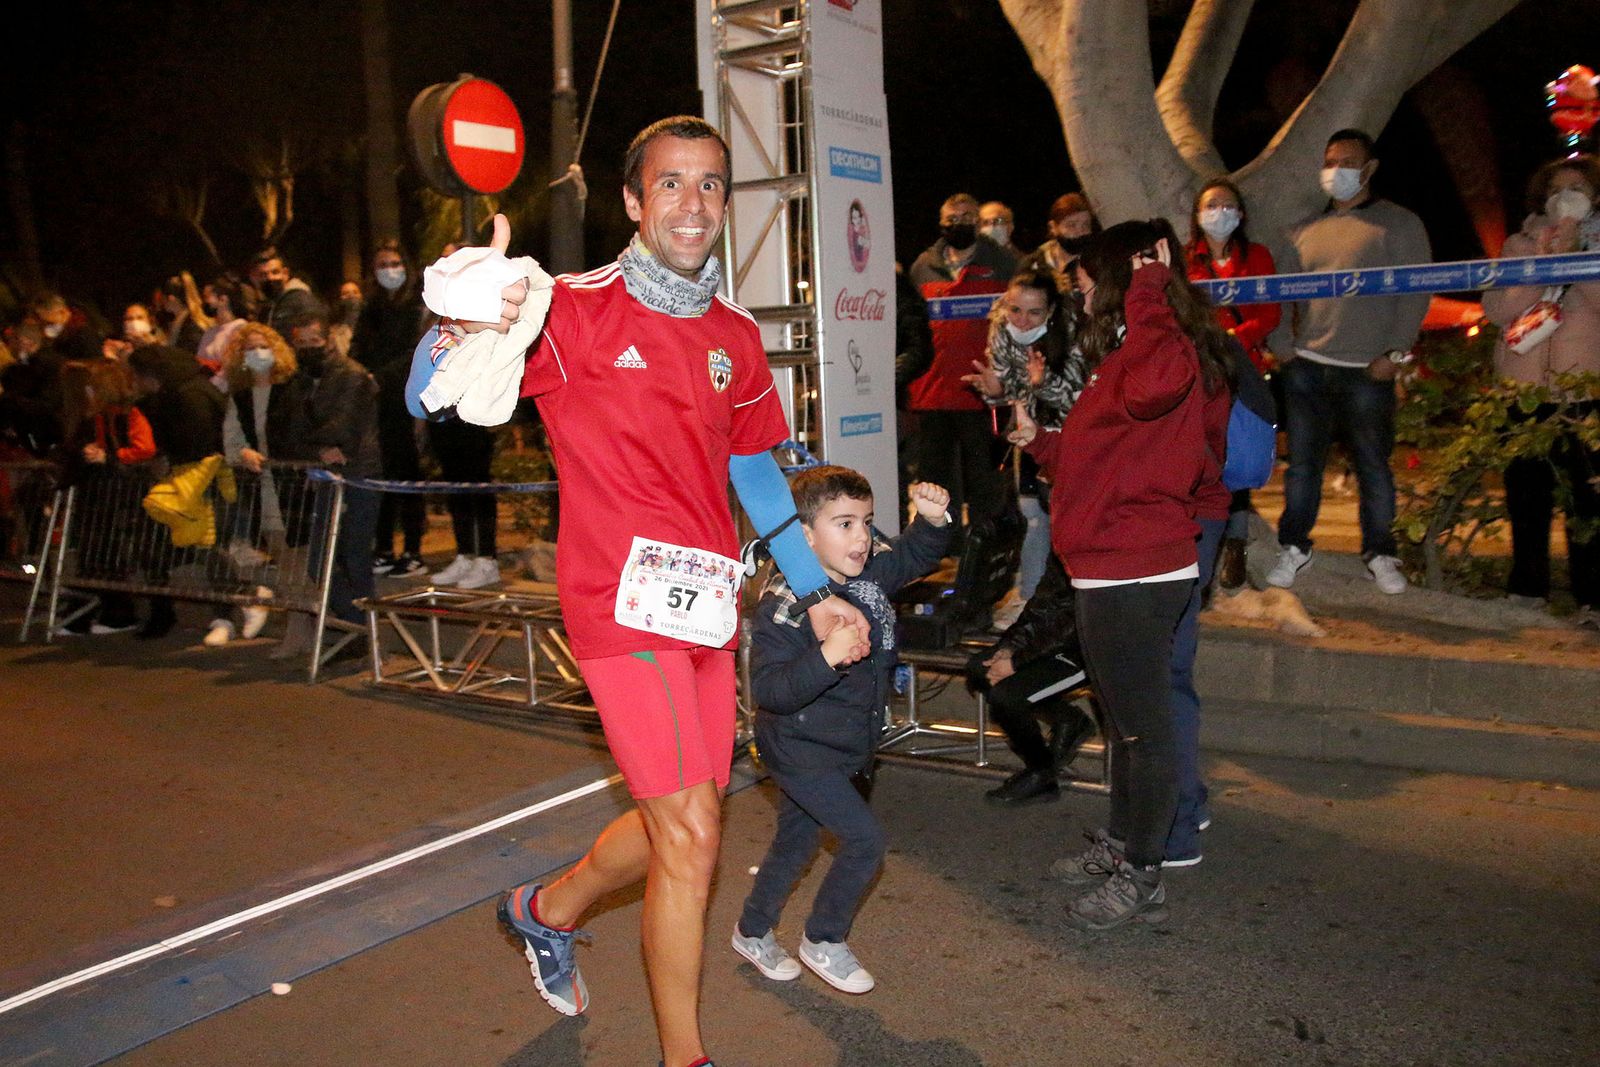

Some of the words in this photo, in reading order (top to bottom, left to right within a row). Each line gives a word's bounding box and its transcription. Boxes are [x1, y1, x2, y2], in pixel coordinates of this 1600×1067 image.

[831, 150, 878, 170] DECATHLON
[613, 360, 648, 369] adidas
[667, 586, 699, 612] 57
[670, 609, 688, 620] PABLO
